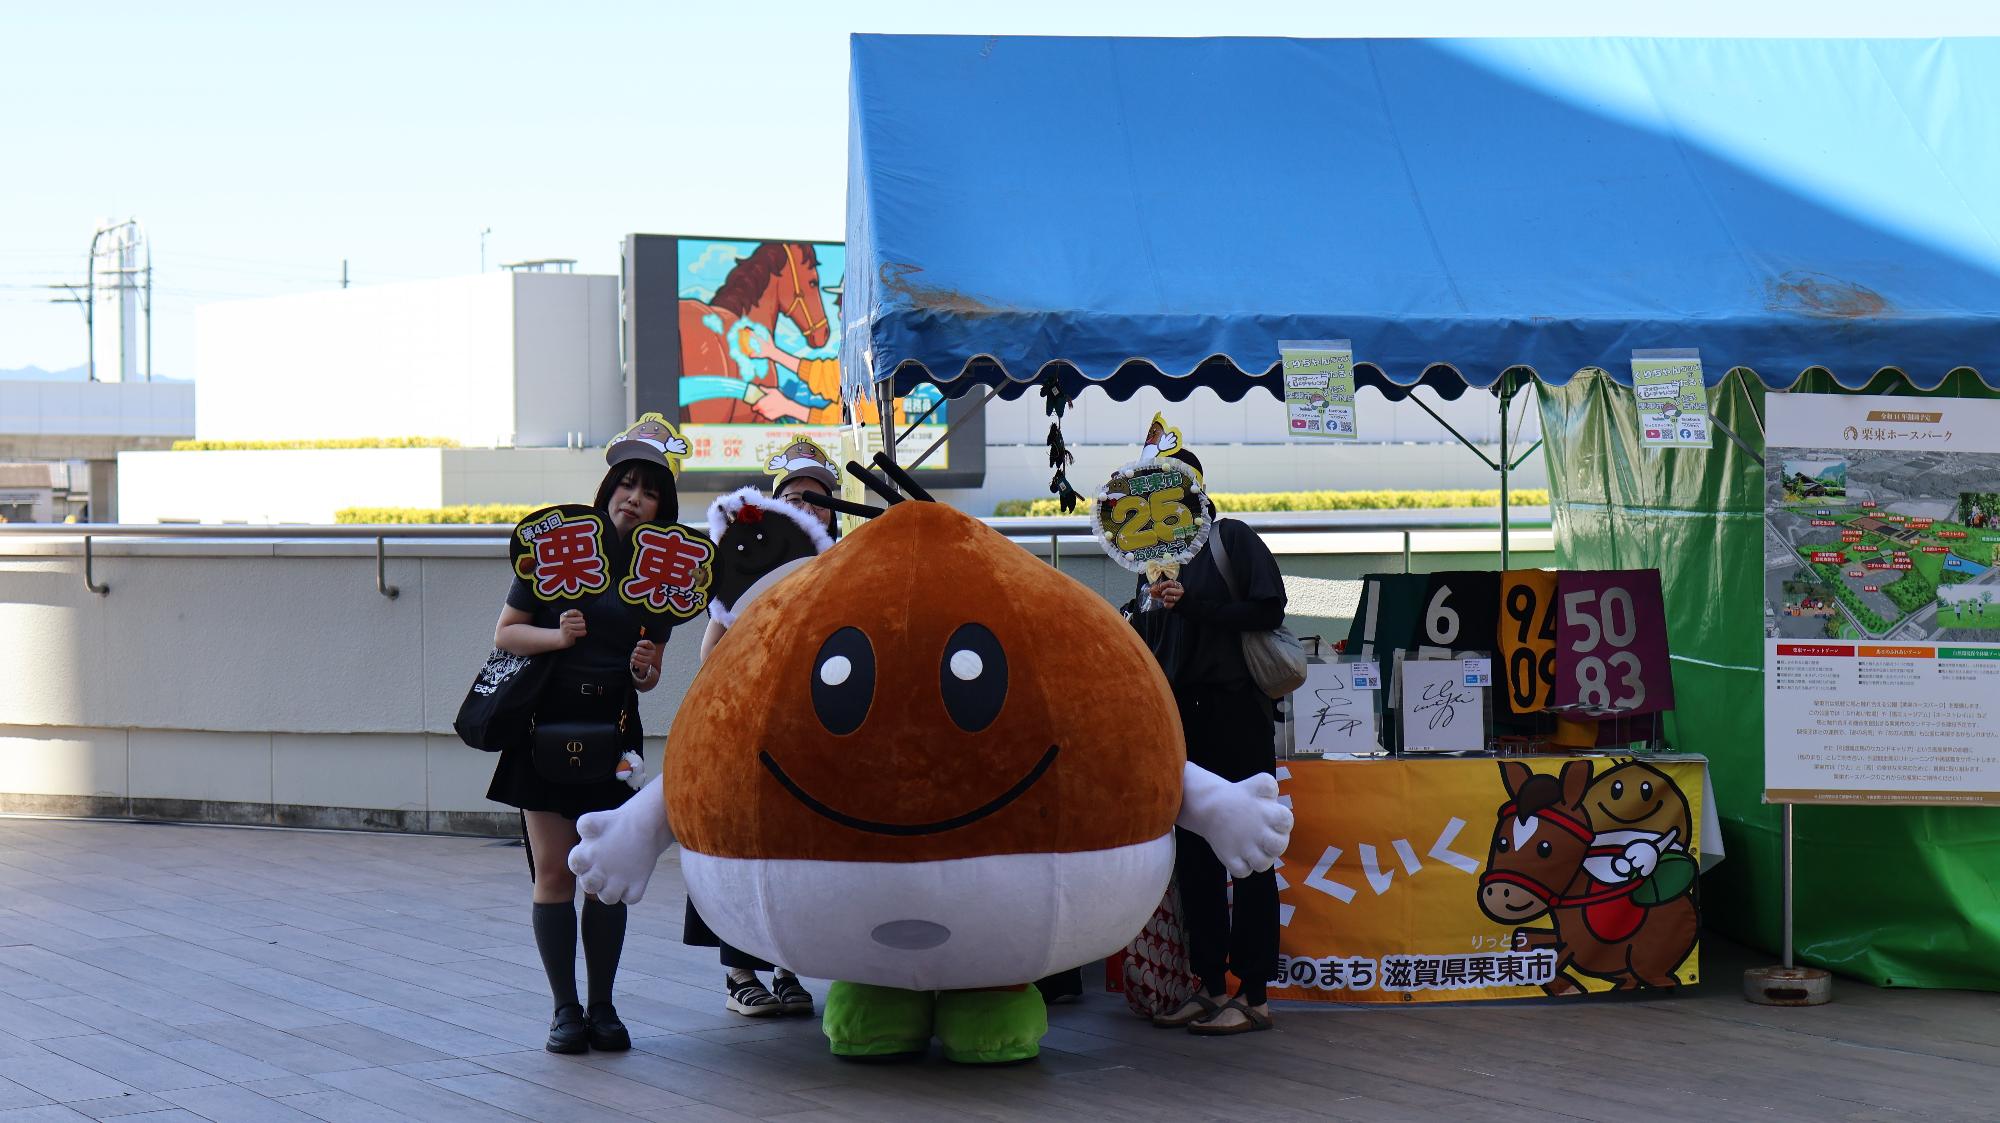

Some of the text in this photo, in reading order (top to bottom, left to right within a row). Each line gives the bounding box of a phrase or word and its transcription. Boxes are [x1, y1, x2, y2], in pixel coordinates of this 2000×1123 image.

[1862, 427, 1953, 441] 栗東ホースパーク
[520, 513, 563, 541] 第43回
[1111, 486, 1194, 552] 25
[534, 520, 606, 597] 栗
[624, 530, 710, 613] 東
[659, 583, 704, 605] ステークス
[1425, 584, 1461, 646] 6
[1564, 585, 1637, 653] 50
[1575, 651, 1646, 716] 83
[1385, 953, 1553, 987] 滋賀県栗東市
[1471, 933, 1528, 949] りっとう
